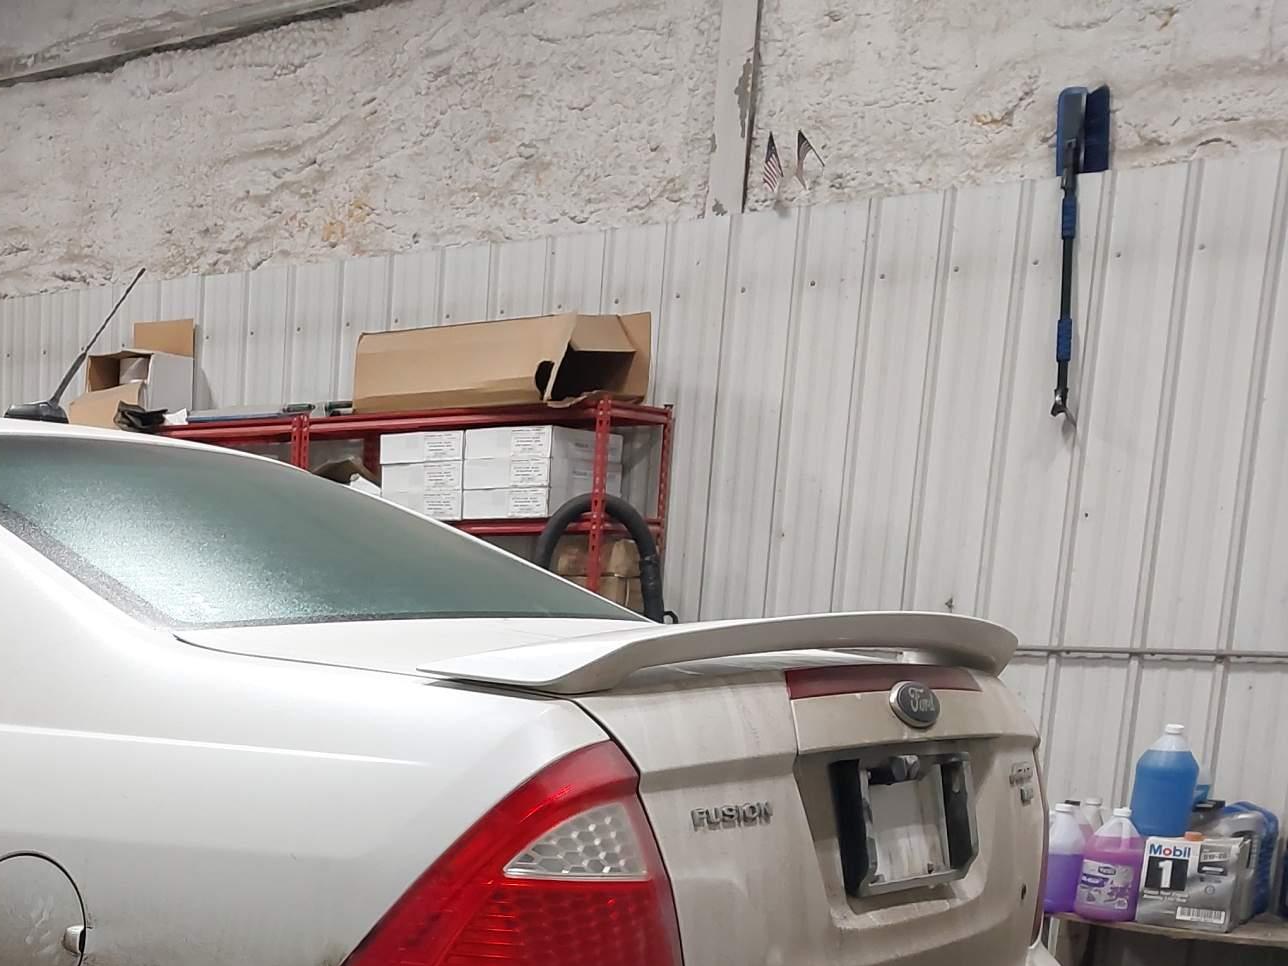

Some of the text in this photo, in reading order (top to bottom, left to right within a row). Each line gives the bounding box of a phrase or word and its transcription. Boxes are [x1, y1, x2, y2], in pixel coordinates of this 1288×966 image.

[908, 687, 937, 713] Ford
[691, 802, 773, 831] FUSION
[1149, 843, 1191, 858] Mobil
[1158, 860, 1173, 889] 1
